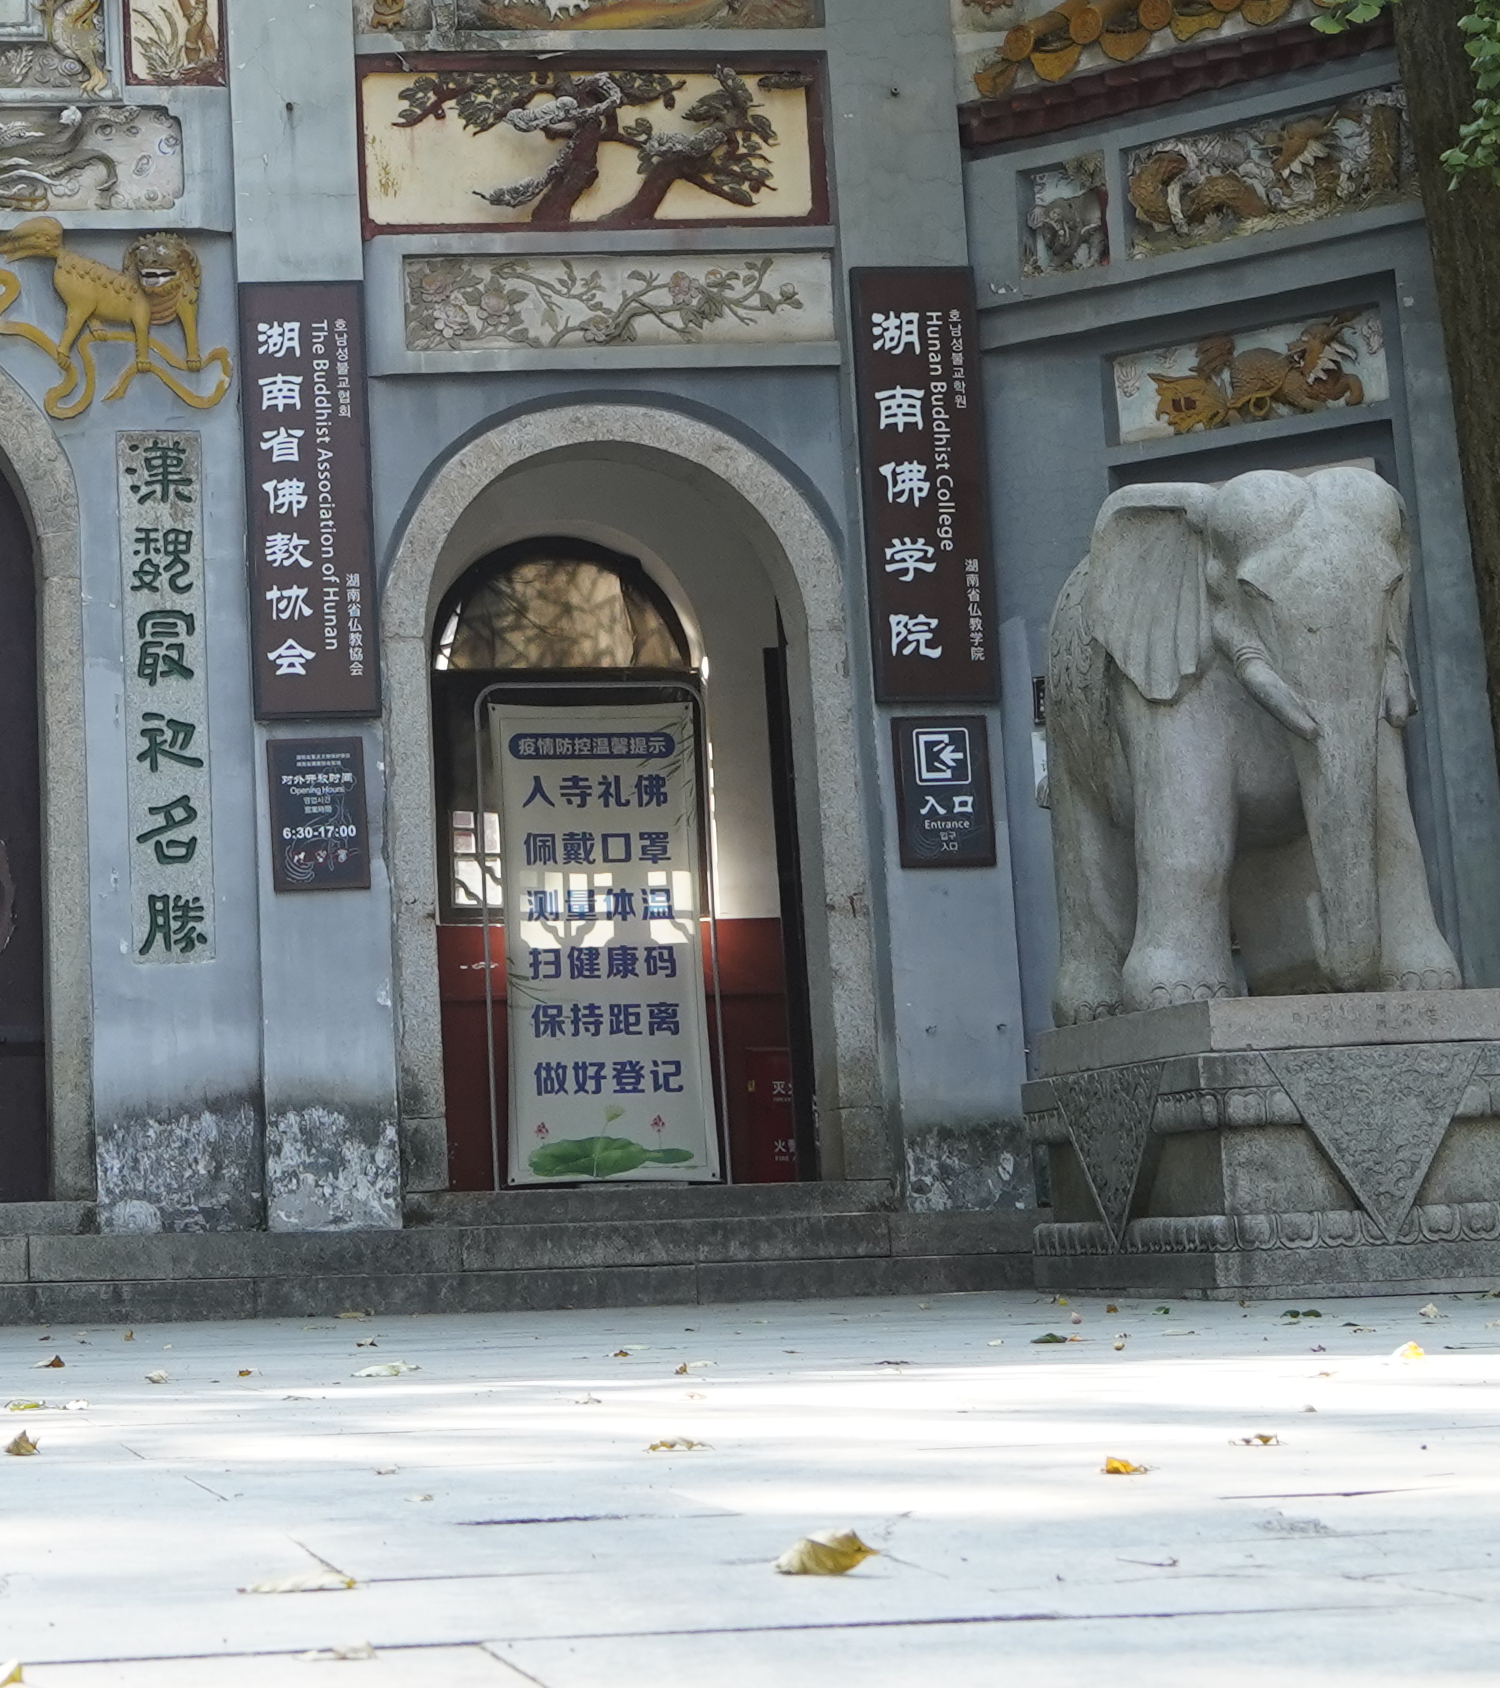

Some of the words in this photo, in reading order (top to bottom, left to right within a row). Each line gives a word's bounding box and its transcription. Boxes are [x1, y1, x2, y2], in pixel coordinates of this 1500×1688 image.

[311, 319, 328, 355] The
[926, 312, 943, 376] Hunan
[312, 359, 333, 444] Buddhist
[930, 381, 952, 470] Buddhist
[257, 320, 317, 676] 湖南省佛教协会
[870, 310, 943, 660] 湖南佛学院
[316, 448, 337, 558] Association
[936, 475, 956, 551] College
[321, 563, 340, 583] of
[323, 588, 340, 650] Hunan
[346, 573, 363, 676] 湖南省仏教協会
[965, 559, 985, 661] 湖南省仏教学院
[518, 737, 666, 755] 疫情防控温馨提示
[281, 772, 353, 785] 对外开放时间
[290, 786, 321, 796] Opening
[322, 785, 345, 794] Hours
[523, 774, 668, 808] 入寺礼佛
[920, 795, 974, 815] 入口
[283, 825, 356, 839] 6:30-17:00
[924, 819, 970, 830] Entrance
[940, 831, 956, 840] 입구
[524, 832, 671, 866] 佩戴口罩
[941, 842, 958, 851] 入口
[527, 888, 674, 921] 测量体温
[529, 945, 677, 980] 扫健康码
[531, 1002, 680, 1038] 保持距离
[534, 1060, 684, 1096] 做好登记
